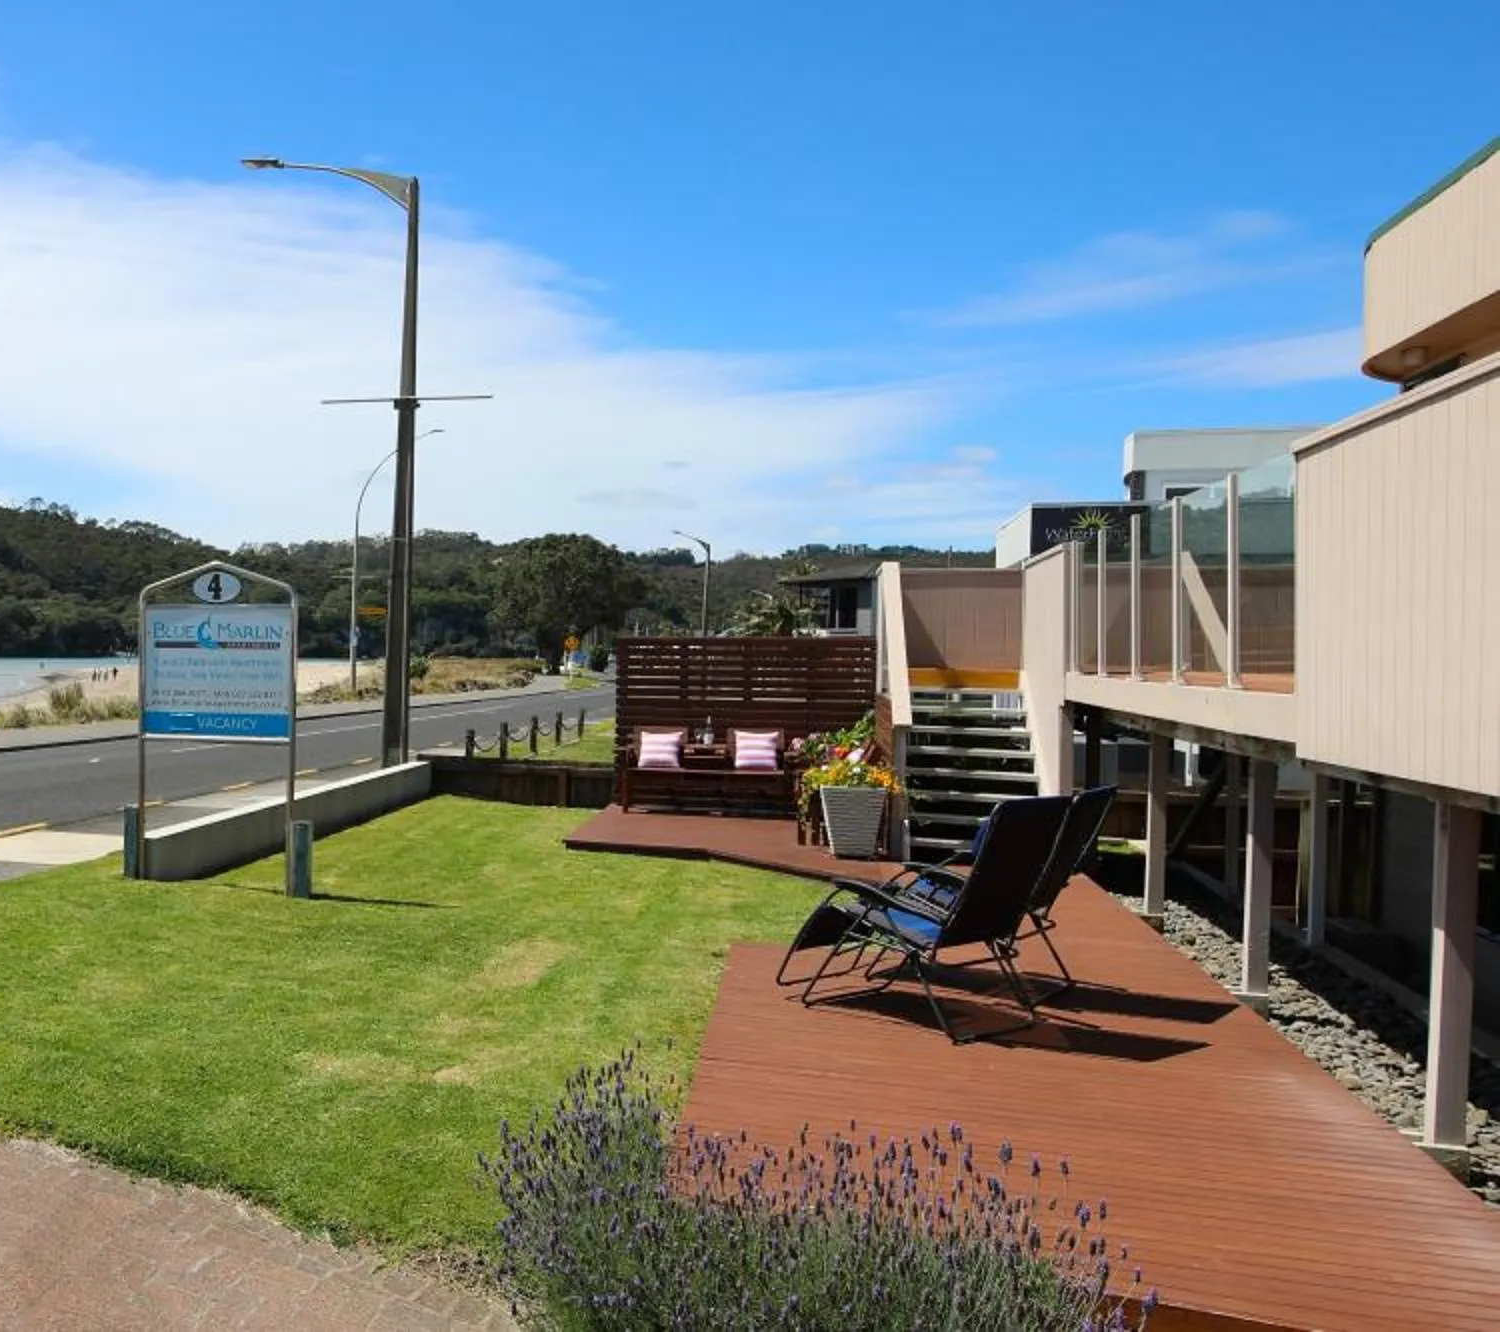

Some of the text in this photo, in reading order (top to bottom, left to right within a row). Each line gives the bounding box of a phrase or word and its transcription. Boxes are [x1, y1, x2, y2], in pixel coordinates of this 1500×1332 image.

[207, 573, 222, 600] 4
[153, 621, 283, 640] BLUE MARLIN
[196, 716, 257, 730] VACANCY
